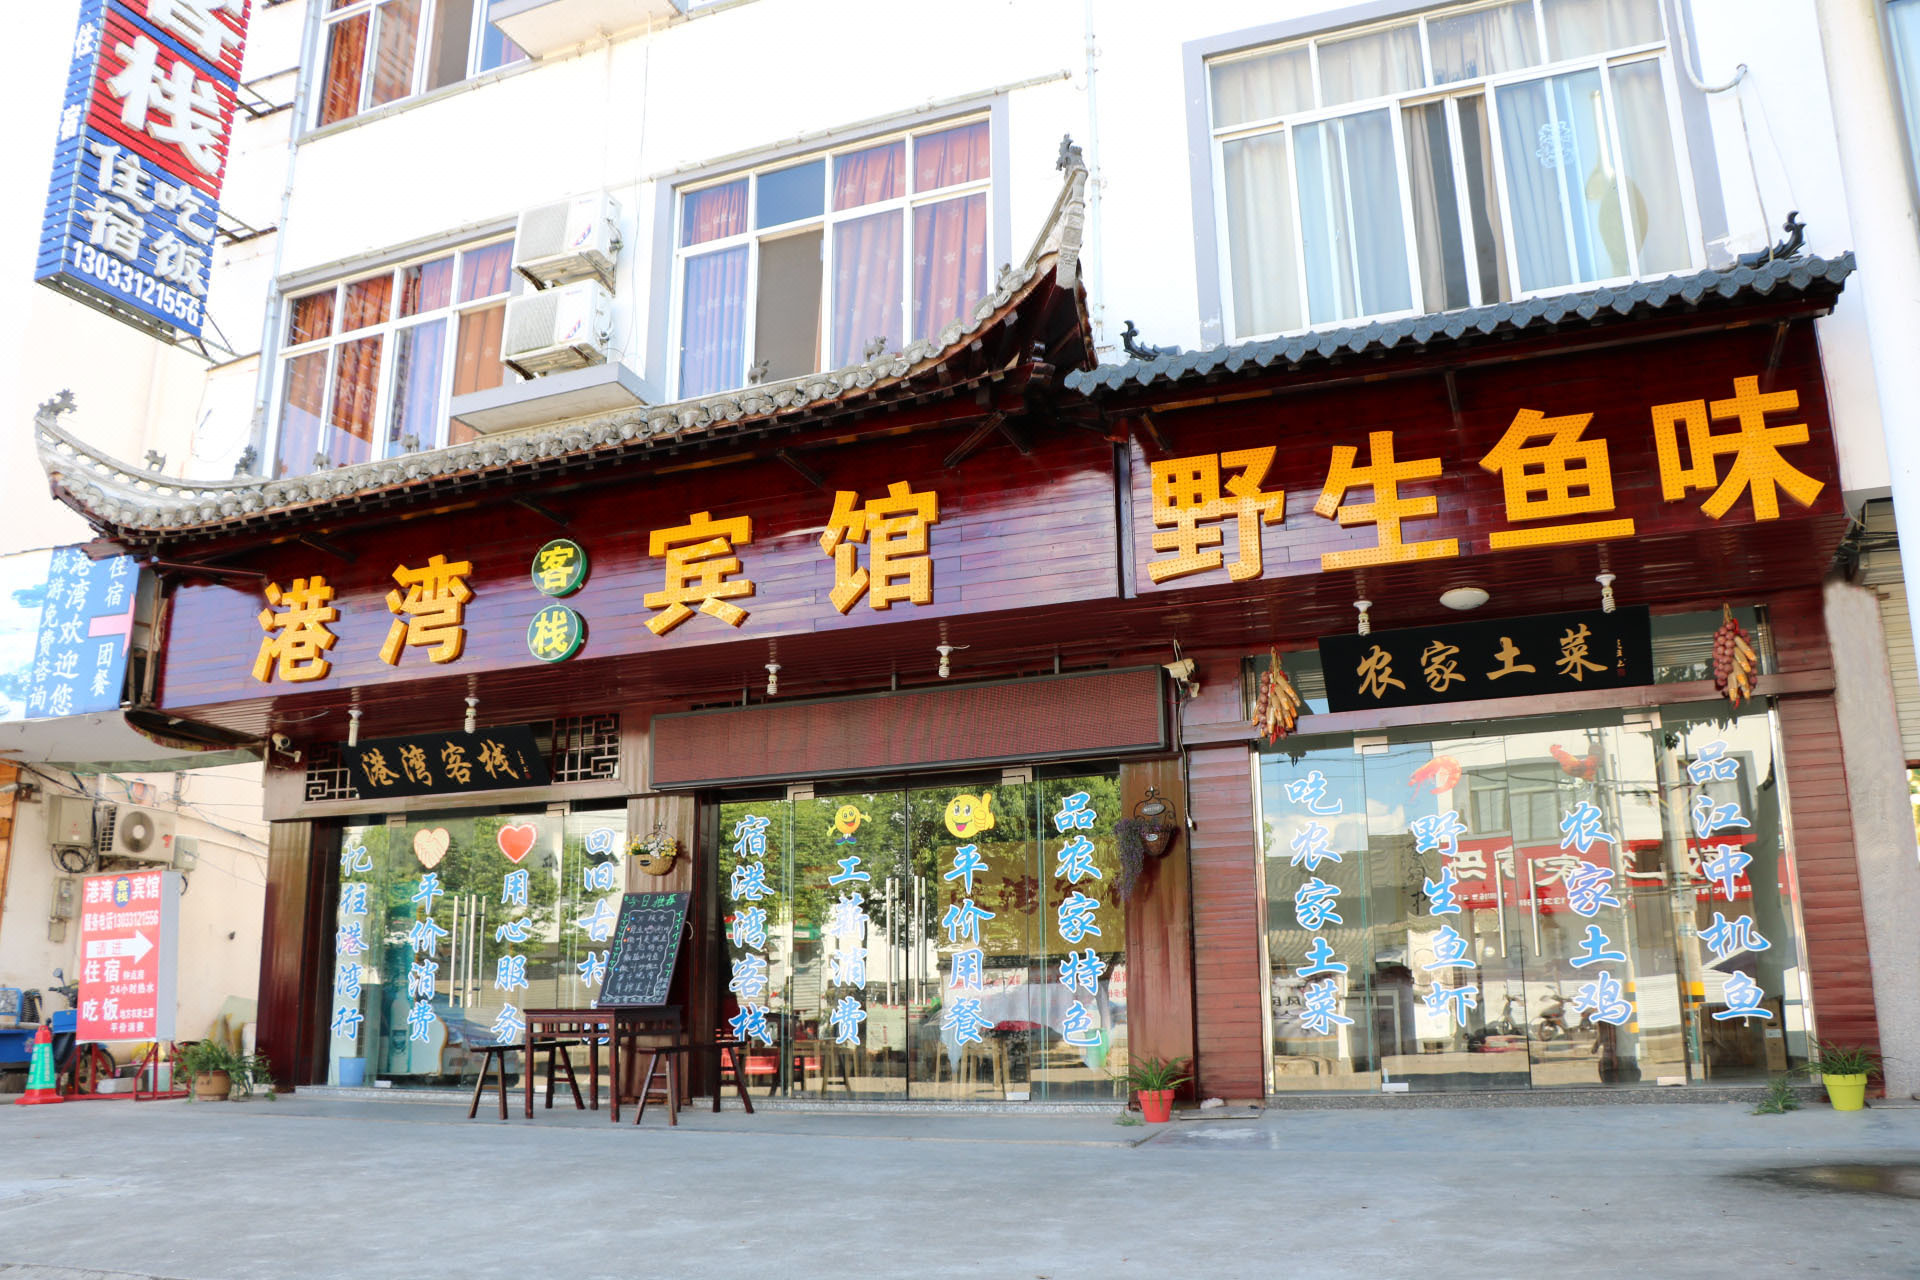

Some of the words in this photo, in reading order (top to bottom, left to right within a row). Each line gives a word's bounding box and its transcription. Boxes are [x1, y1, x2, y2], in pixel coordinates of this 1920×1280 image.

[59, 24, 98, 142] 住宿
[72, 241, 201, 327] 13033121556
[84, 142, 153, 261] 住宿
[151, 181, 214, 297] 吃饭
[1146, 375, 1826, 583] 野生鱼味
[49, 550, 96, 716] 港湾欢迎您
[104, 555, 128, 608] 住宿
[252, 554, 473, 683] 港湾
[532, 545, 575, 655] 客栈
[643, 480, 939, 636] 宾馆
[1356, 622, 1608, 699] 农家土菜
[90, 642, 114, 697] 团餐
[361, 738, 519, 788] 港湾客栈
[85, 879, 114, 904] 港湾
[116, 879, 130, 903] 客栈
[131, 874, 160, 900] 宾馆
[331, 842, 373, 1041] 忆往港湾行
[407, 872, 448, 1044] 平价消费
[491, 869, 532, 1046] 用心服务
[728, 814, 775, 1047] 宿港湾客栈
[828, 856, 871, 1047] 工薪消费
[941, 843, 996, 1047] 平价用餐
[1053, 790, 1106, 1048] 品农家特色
[1283, 769, 1355, 1036] 吃农家土菜
[1410, 810, 1479, 1028] 野生鱼虾
[1558, 801, 1635, 1028] 农家土鸡
[1686, 740, 1774, 1021] 品江中机鱼
[82, 997, 120, 1022] 吃饭
[84, 958, 121, 985] 住宿
